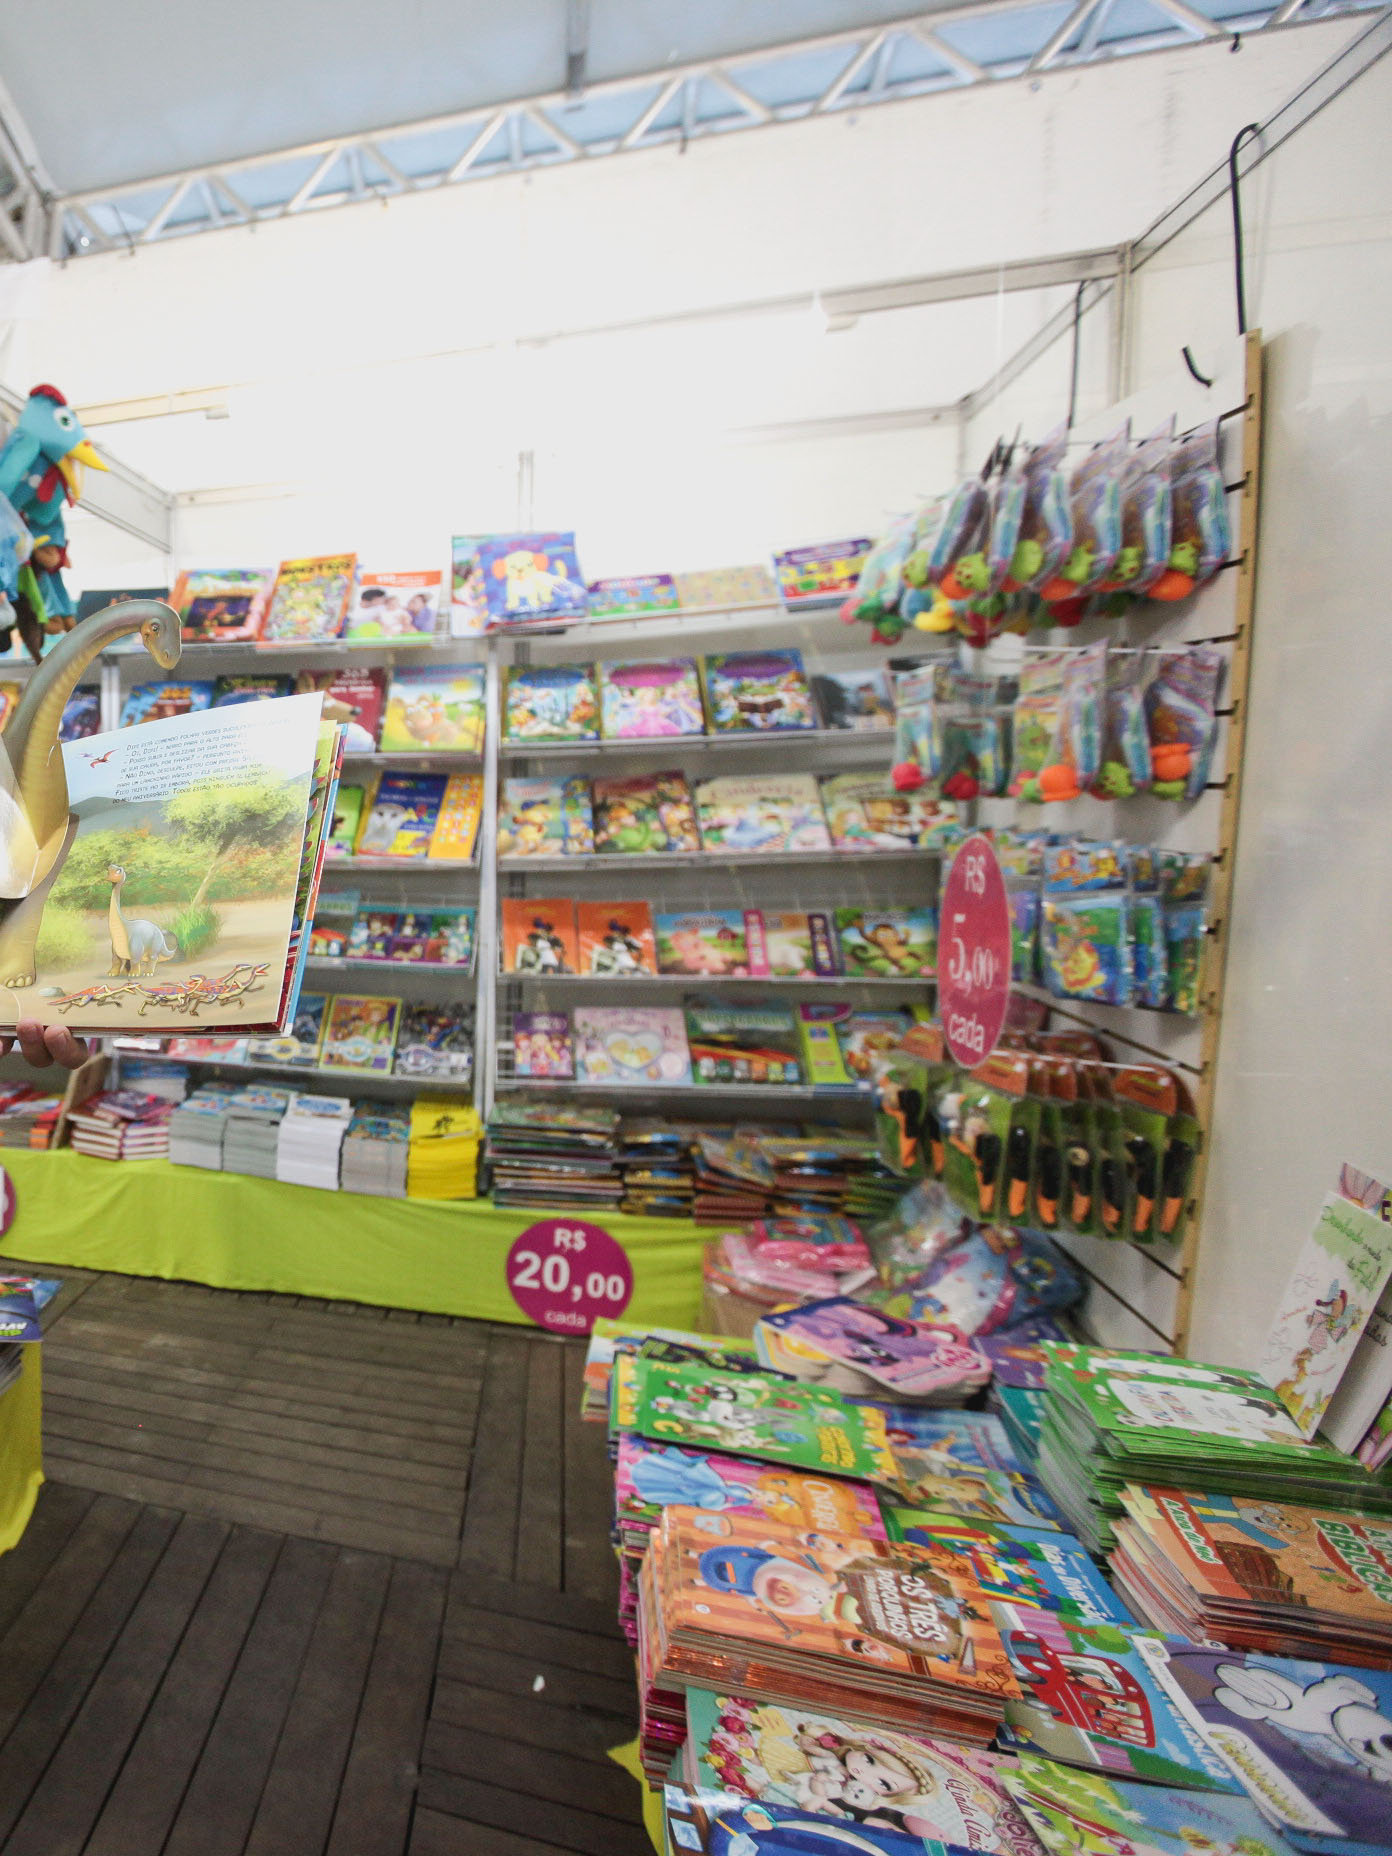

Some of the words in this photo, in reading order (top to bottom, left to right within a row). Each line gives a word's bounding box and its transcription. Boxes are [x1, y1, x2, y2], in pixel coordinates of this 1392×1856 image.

[965, 856, 985, 894] R$
[948, 913, 994, 997] 5,00
[949, 1013, 985, 1053] cada
[554, 1228, 587, 1251] R$
[513, 1250, 626, 1303] 20,00
[544, 1310, 587, 1328] cada
[874, 1568, 913, 1640] PORQUINHOS
[900, 1574, 934, 1600] OS
[909, 1601, 949, 1643] TRÊS
[944, 1778, 978, 1816] Linda
